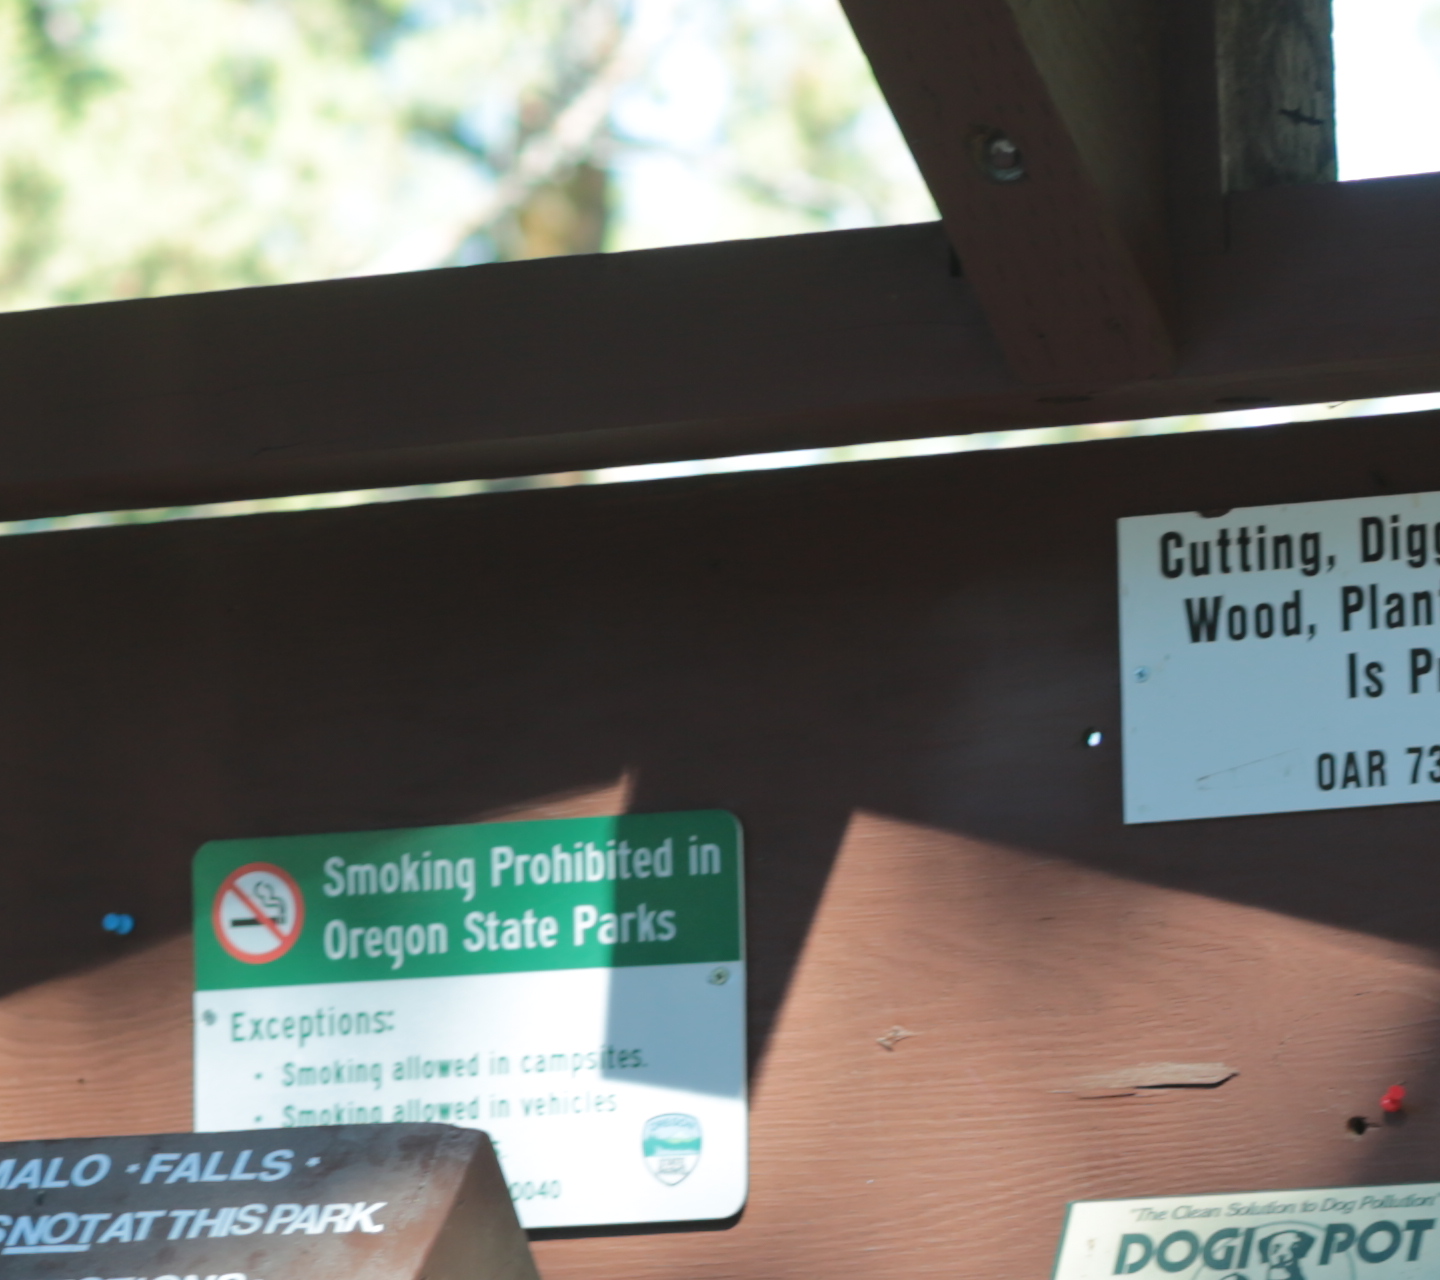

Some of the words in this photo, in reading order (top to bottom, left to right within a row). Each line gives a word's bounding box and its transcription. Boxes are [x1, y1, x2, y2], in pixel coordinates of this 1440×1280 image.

[1160, 523, 1336, 580] Cutting,
[1185, 590, 1318, 644] Wood,
[1347, 653, 1385, 700] Is
[1316, 749, 1388, 792] OAR
[323, 850, 475, 902] Smoking
[490, 838, 673, 888] Prohibited
[689, 835, 721, 876] in
[323, 916, 448, 970] Oregon
[463, 907, 560, 953] State
[572, 902, 678, 947] Parks
[230, 1006, 396, 1047] Exceptions:
[281, 1056, 382, 1090] Smoking
[392, 1051, 479, 1082] allowed
[489, 1048, 511, 1075] in
[520, 1042, 649, 1075] campsites.
[281, 1101, 383, 1128] Smoking
[393, 1096, 480, 1124] allowed
[489, 1095, 510, 1118] in
[140, 1147, 296, 1187] FALLS
[7, 1211, 108, 1248] NOT
[96, 1209, 166, 1243] AT
[168, 1205, 264, 1240] THIS
[262, 1201, 388, 1236] PARK.
[1171, 1202, 1221, 1220] Clean
[1224, 1197, 1299, 1218] Solution
[1302, 1198, 1317, 1213] to
[1319, 1195, 1356, 1215] Dog
